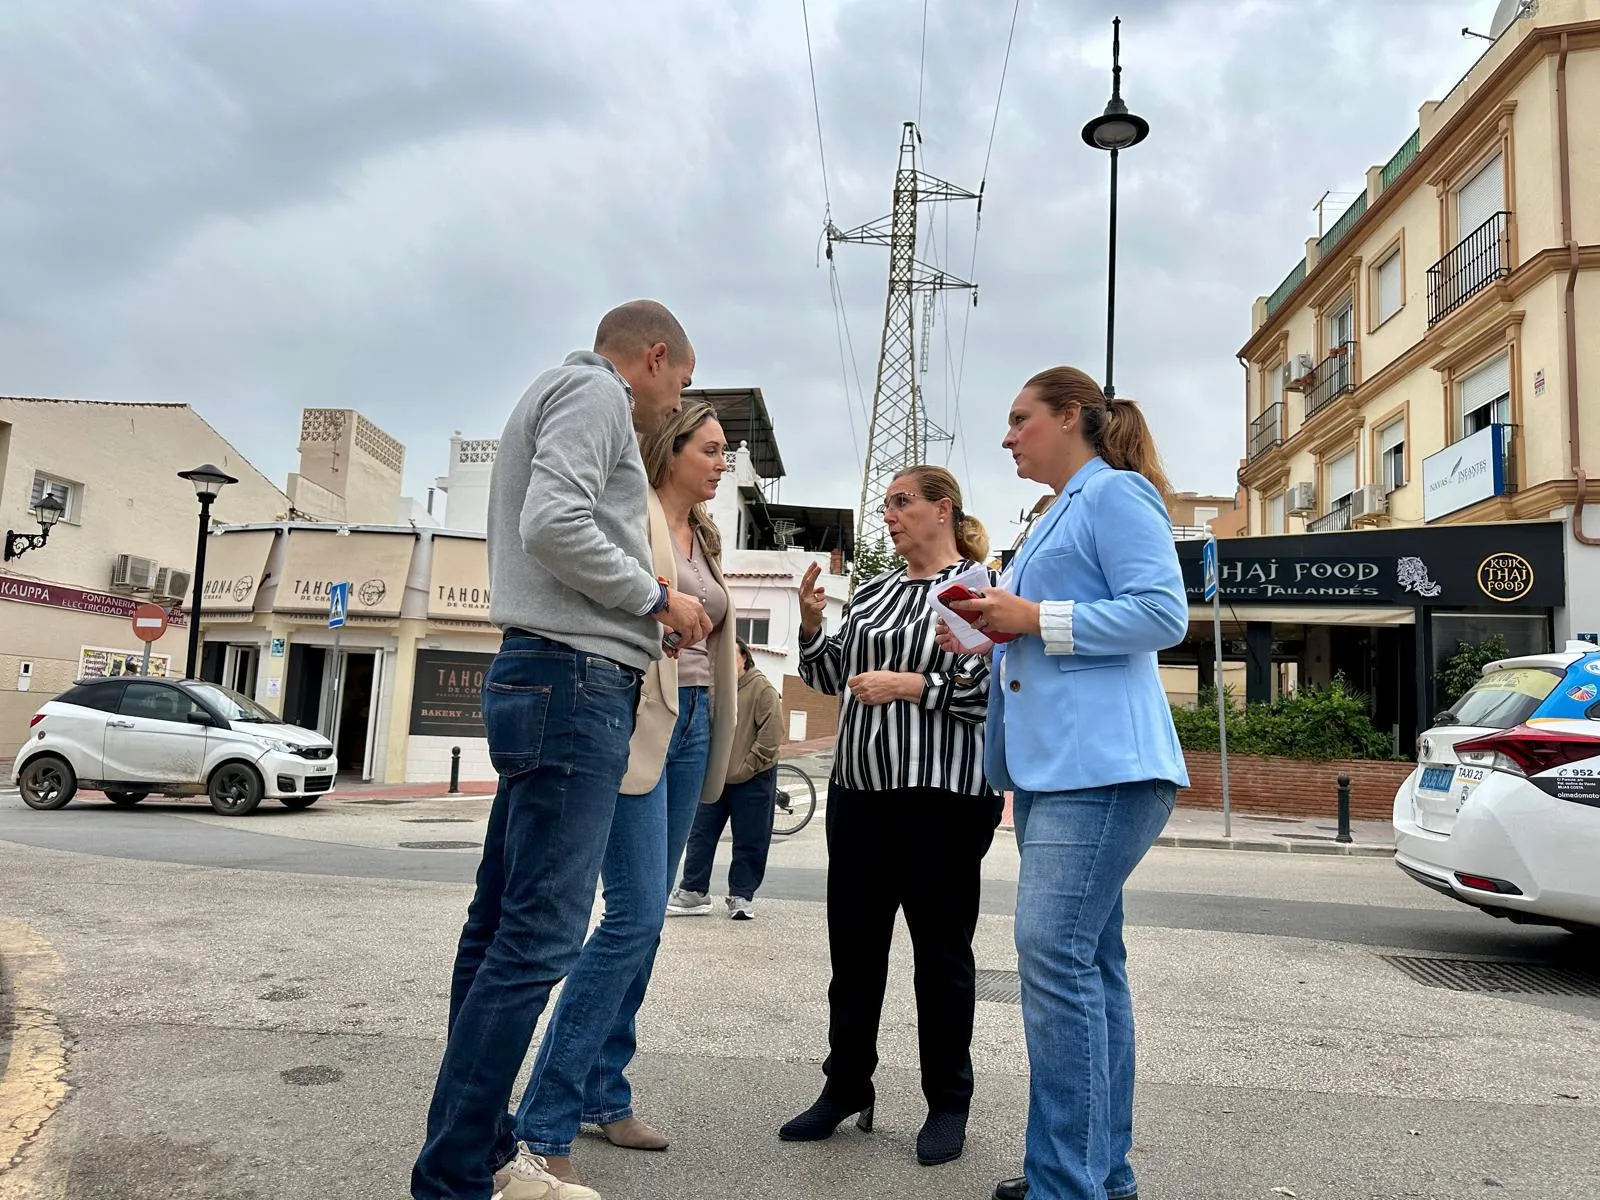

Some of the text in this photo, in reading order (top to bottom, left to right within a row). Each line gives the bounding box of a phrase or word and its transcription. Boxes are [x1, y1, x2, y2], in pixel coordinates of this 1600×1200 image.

[1199, 559, 1379, 582] HAI FOOD
[1490, 559, 1522, 568] KUIK
[1485, 566, 1527, 582] THAI
[1, 582, 50, 600] KAUPPA
[204, 580, 232, 594] HONA
[294, 580, 354, 597] TAHOA
[1260, 584, 1379, 597] TAILANDÉS
[1488, 581, 1524, 592] FOOD
[82, 592, 136, 609] FONTANERIA
[438, 586, 491, 603] TAHON
[62, 600, 122, 615] ELECTRICIDAD
[438, 669, 484, 688] TAHO
[421, 709, 462, 717] BAKERY
[1459, 768, 1484, 780] TAXI 23
